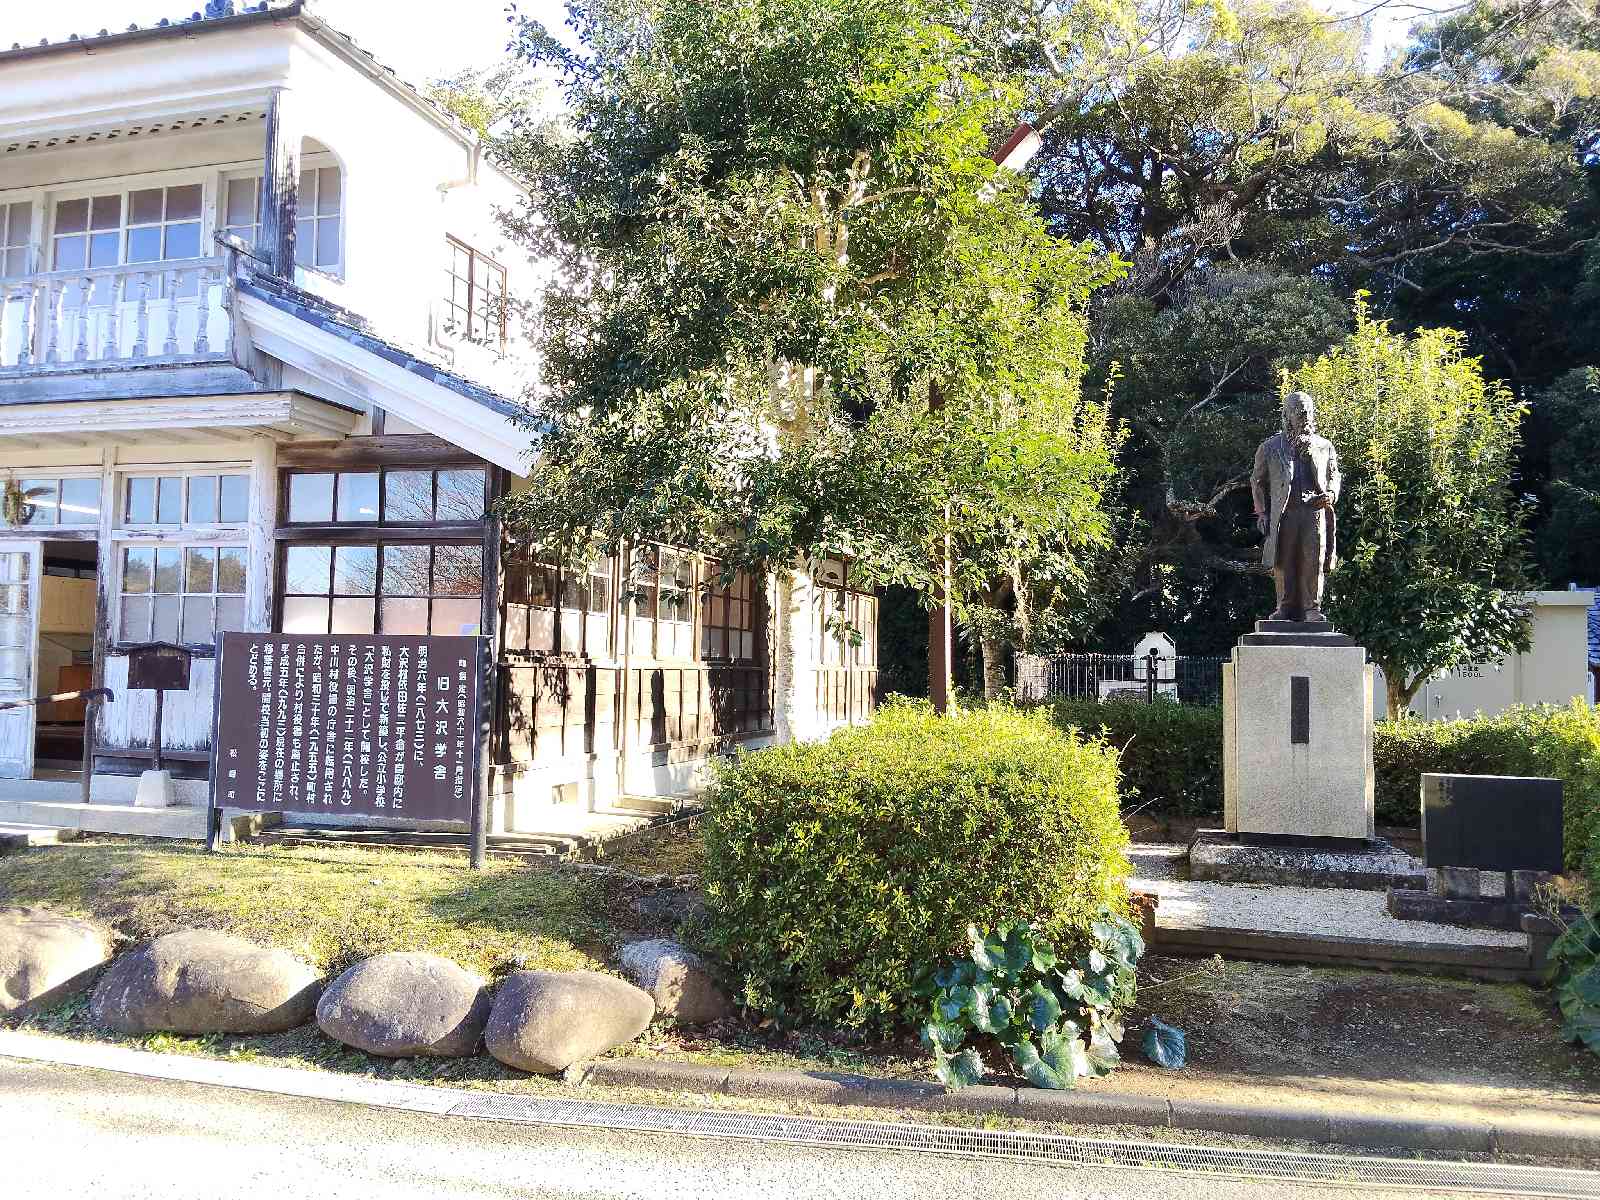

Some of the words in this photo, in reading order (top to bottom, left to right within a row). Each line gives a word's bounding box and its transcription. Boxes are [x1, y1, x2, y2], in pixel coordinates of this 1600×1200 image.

[434, 676, 450, 780] 旧大沢学舎
